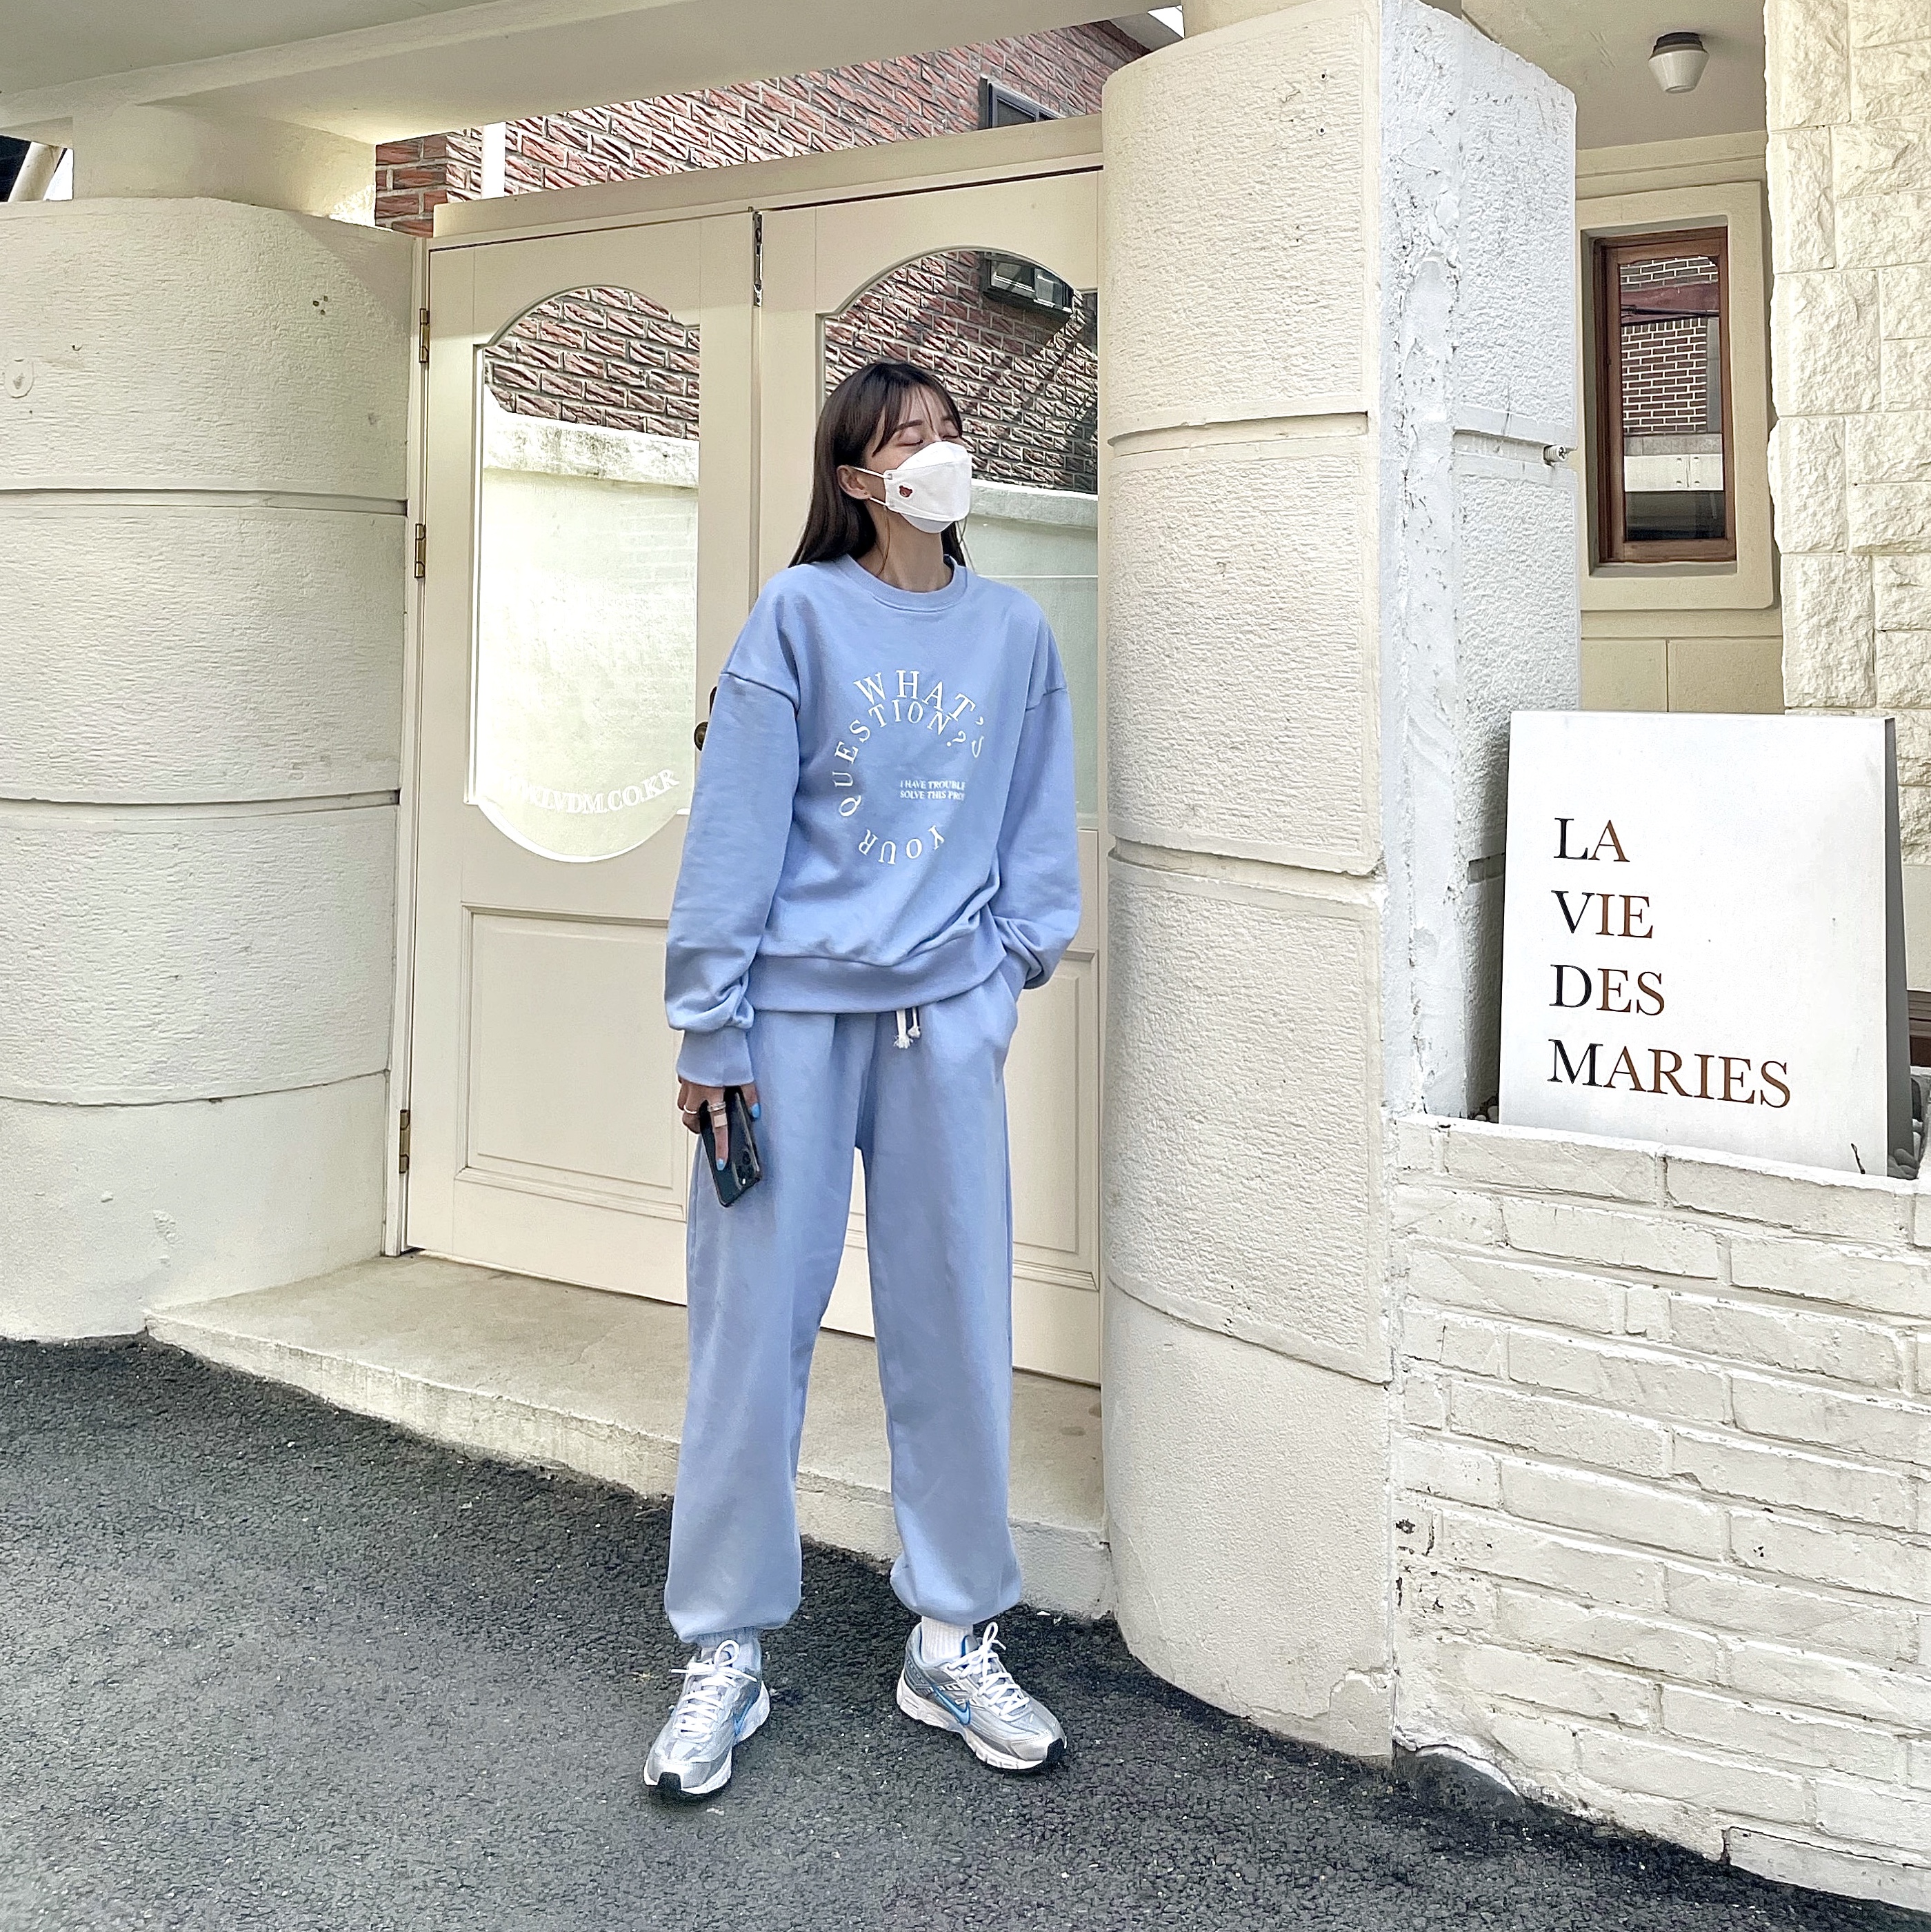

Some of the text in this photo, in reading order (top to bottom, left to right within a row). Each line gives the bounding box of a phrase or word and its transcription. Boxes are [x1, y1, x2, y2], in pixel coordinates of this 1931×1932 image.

[832, 699, 966, 817] QUESTION?
[900, 790, 926, 799] SOLVE
[927, 790, 947, 799] THIS
[905, 779, 927, 789] HAVE
[858, 824, 946, 865] YOUR
[1553, 817, 1630, 862] LA
[1551, 890, 1654, 939] VIE
[1549, 964, 1665, 1016] DES
[1548, 1038, 1791, 1108] MARIES
